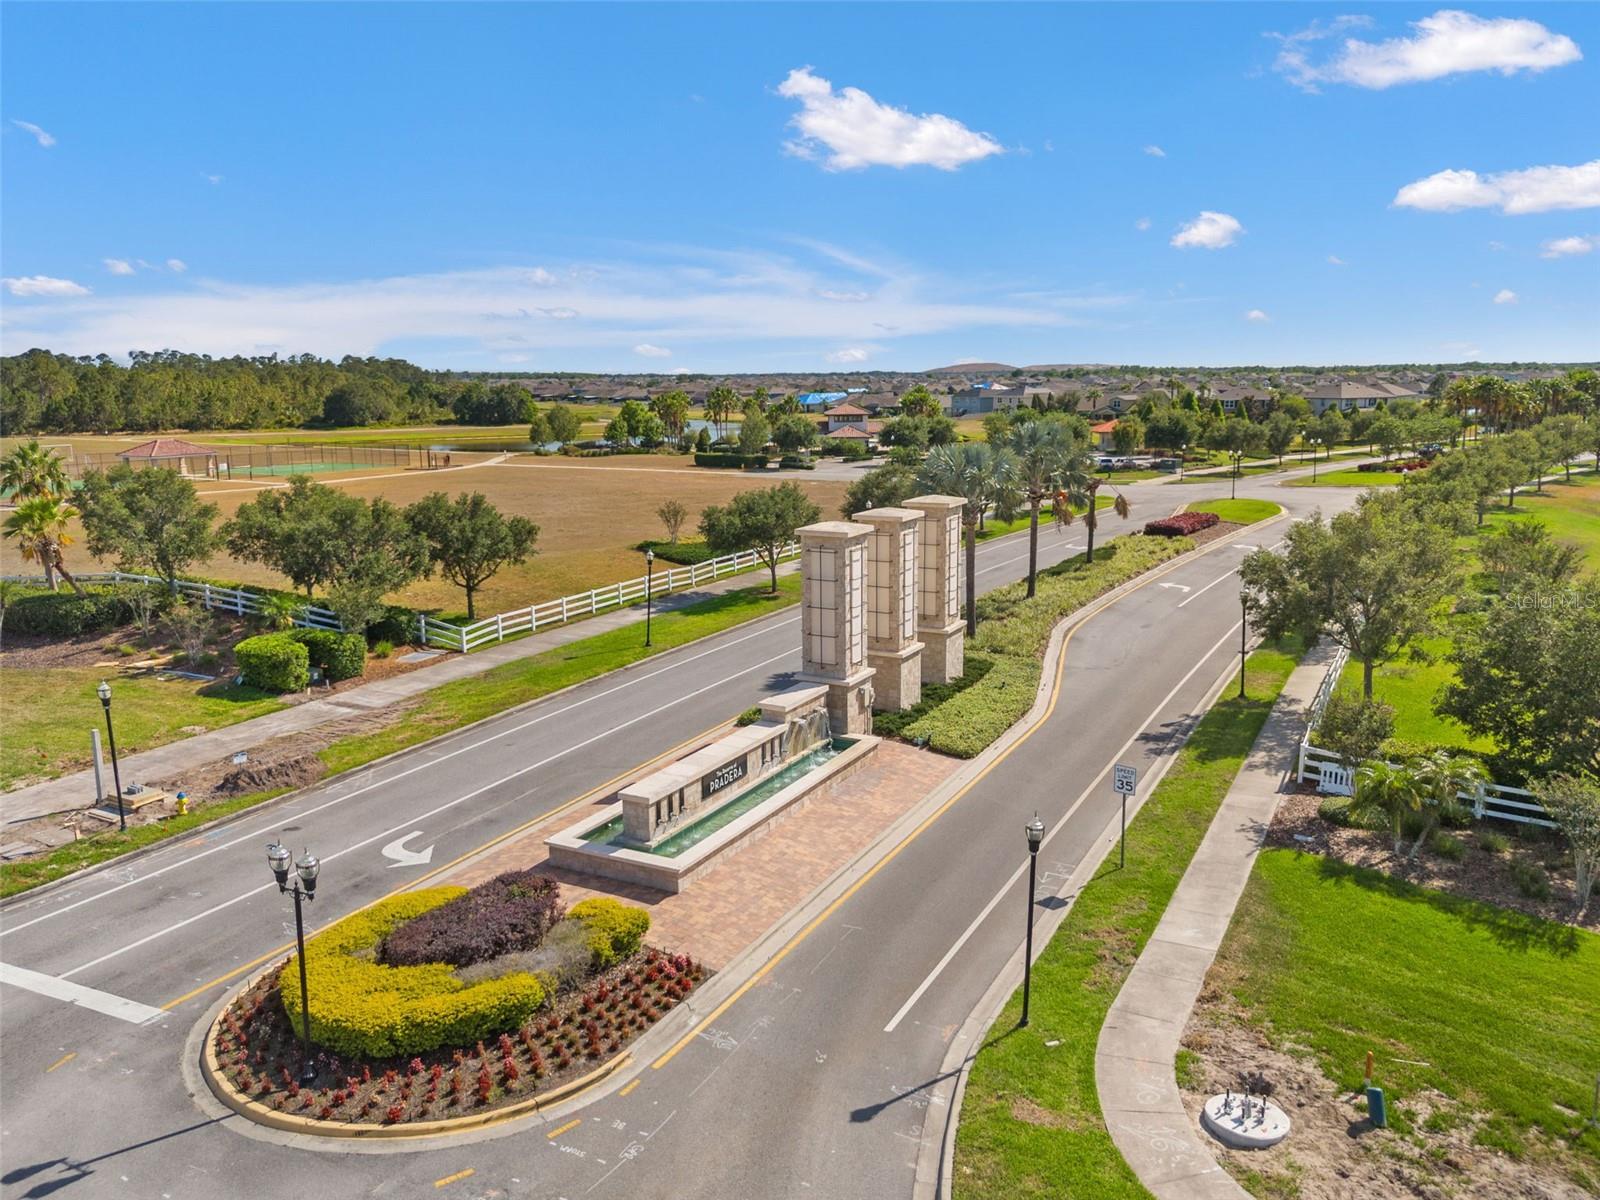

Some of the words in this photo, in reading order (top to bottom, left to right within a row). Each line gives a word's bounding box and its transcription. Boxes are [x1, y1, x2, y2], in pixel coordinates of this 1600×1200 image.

[1116, 767, 1135, 776] SPEED
[710, 765, 743, 793] PRADERA
[1116, 778, 1133, 792] 35
